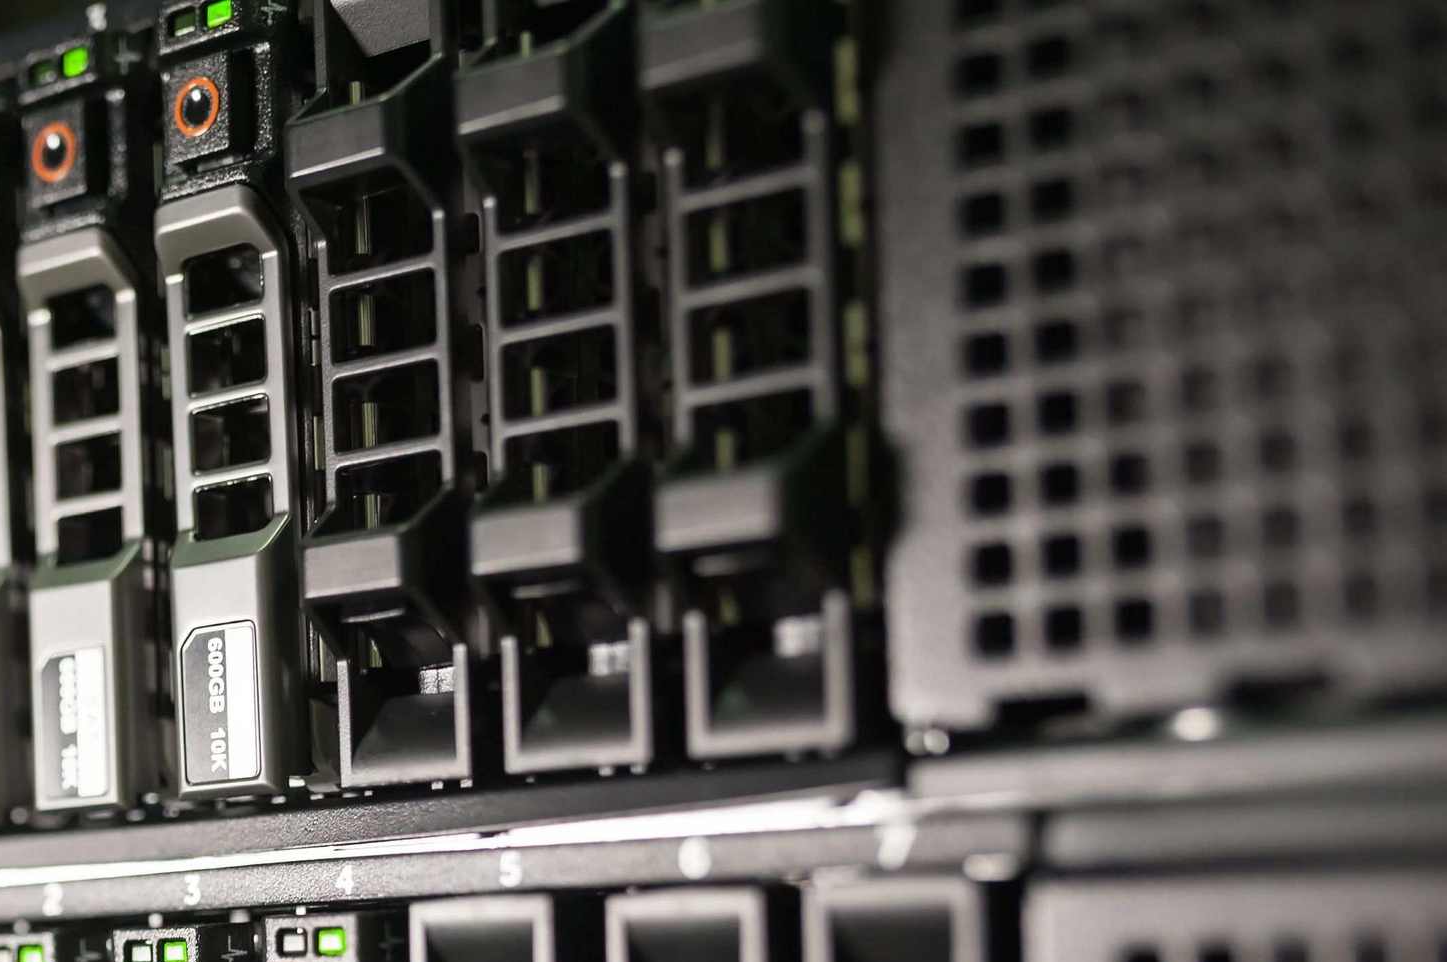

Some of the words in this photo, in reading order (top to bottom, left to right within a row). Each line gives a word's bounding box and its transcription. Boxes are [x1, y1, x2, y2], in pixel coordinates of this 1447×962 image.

[207, 637, 226, 714] 600GB
[210, 727, 227, 773] 10K
[184, 873, 202, 906] 3
[335, 864, 354, 896] 4
[499, 849, 522, 888] 5
